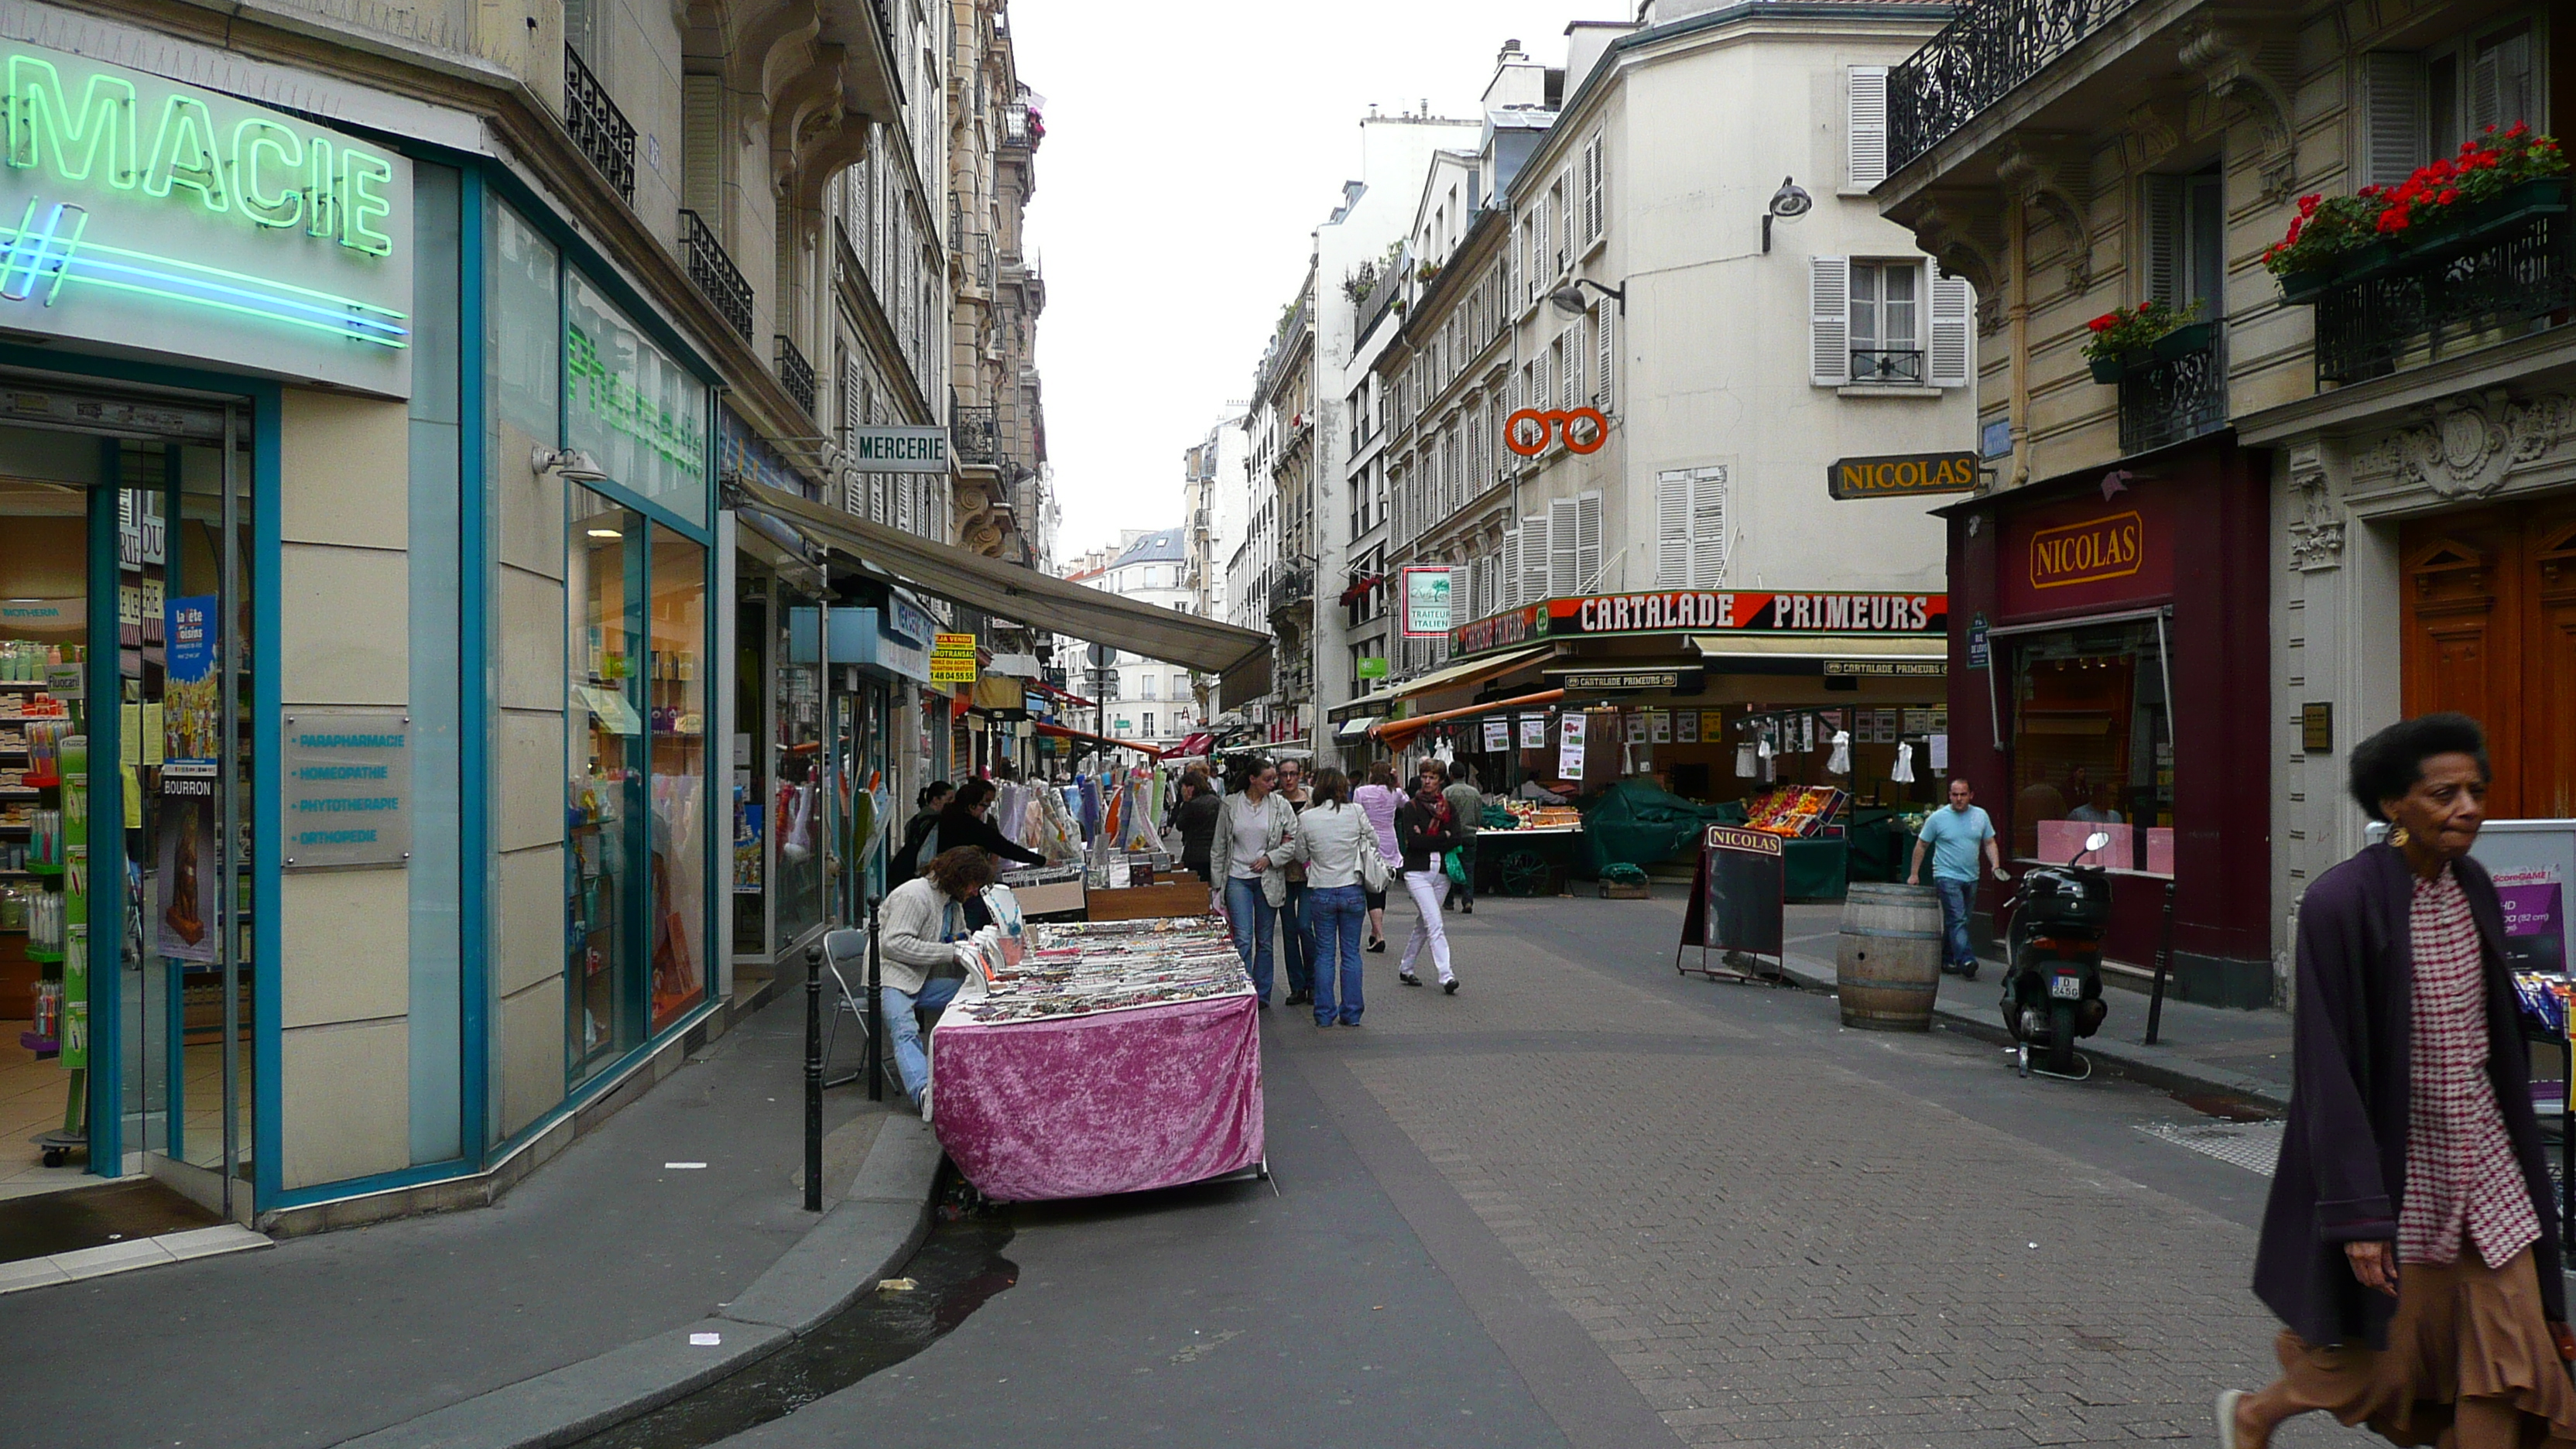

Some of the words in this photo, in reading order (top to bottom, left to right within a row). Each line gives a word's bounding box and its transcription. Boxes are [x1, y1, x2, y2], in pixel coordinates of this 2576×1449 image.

[8, 54, 392, 257] MACIE
[859, 436, 944, 460] MERCERIE
[1841, 458, 1972, 491] NICOLAS
[2036, 525, 2136, 576] NICOLAS
[176, 609, 185, 623] la
[1581, 593, 1735, 632] CARTALADE
[1773, 594, 1927, 630] PRIMEURS
[1495, 609, 1526, 645] PRIMEURS
[1841, 664, 1893, 673] CARTALADE
[1896, 664, 1940, 673] PRIMEURS
[1580, 677, 1622, 686] CARTALADE
[1623, 676, 1660, 685] PRIMEURS
[300, 735, 405, 747] PARAPHARMACIE
[300, 766, 388, 779] HOMEOPATHIE
[165, 780, 211, 795] BOURRON
[300, 797, 399, 811] PHYTOTHERAPIE
[300, 830, 377, 844] ORTHOPEDIE
[1713, 831, 1777, 851] NICOLAS
[2064, 978, 2070, 987] D
